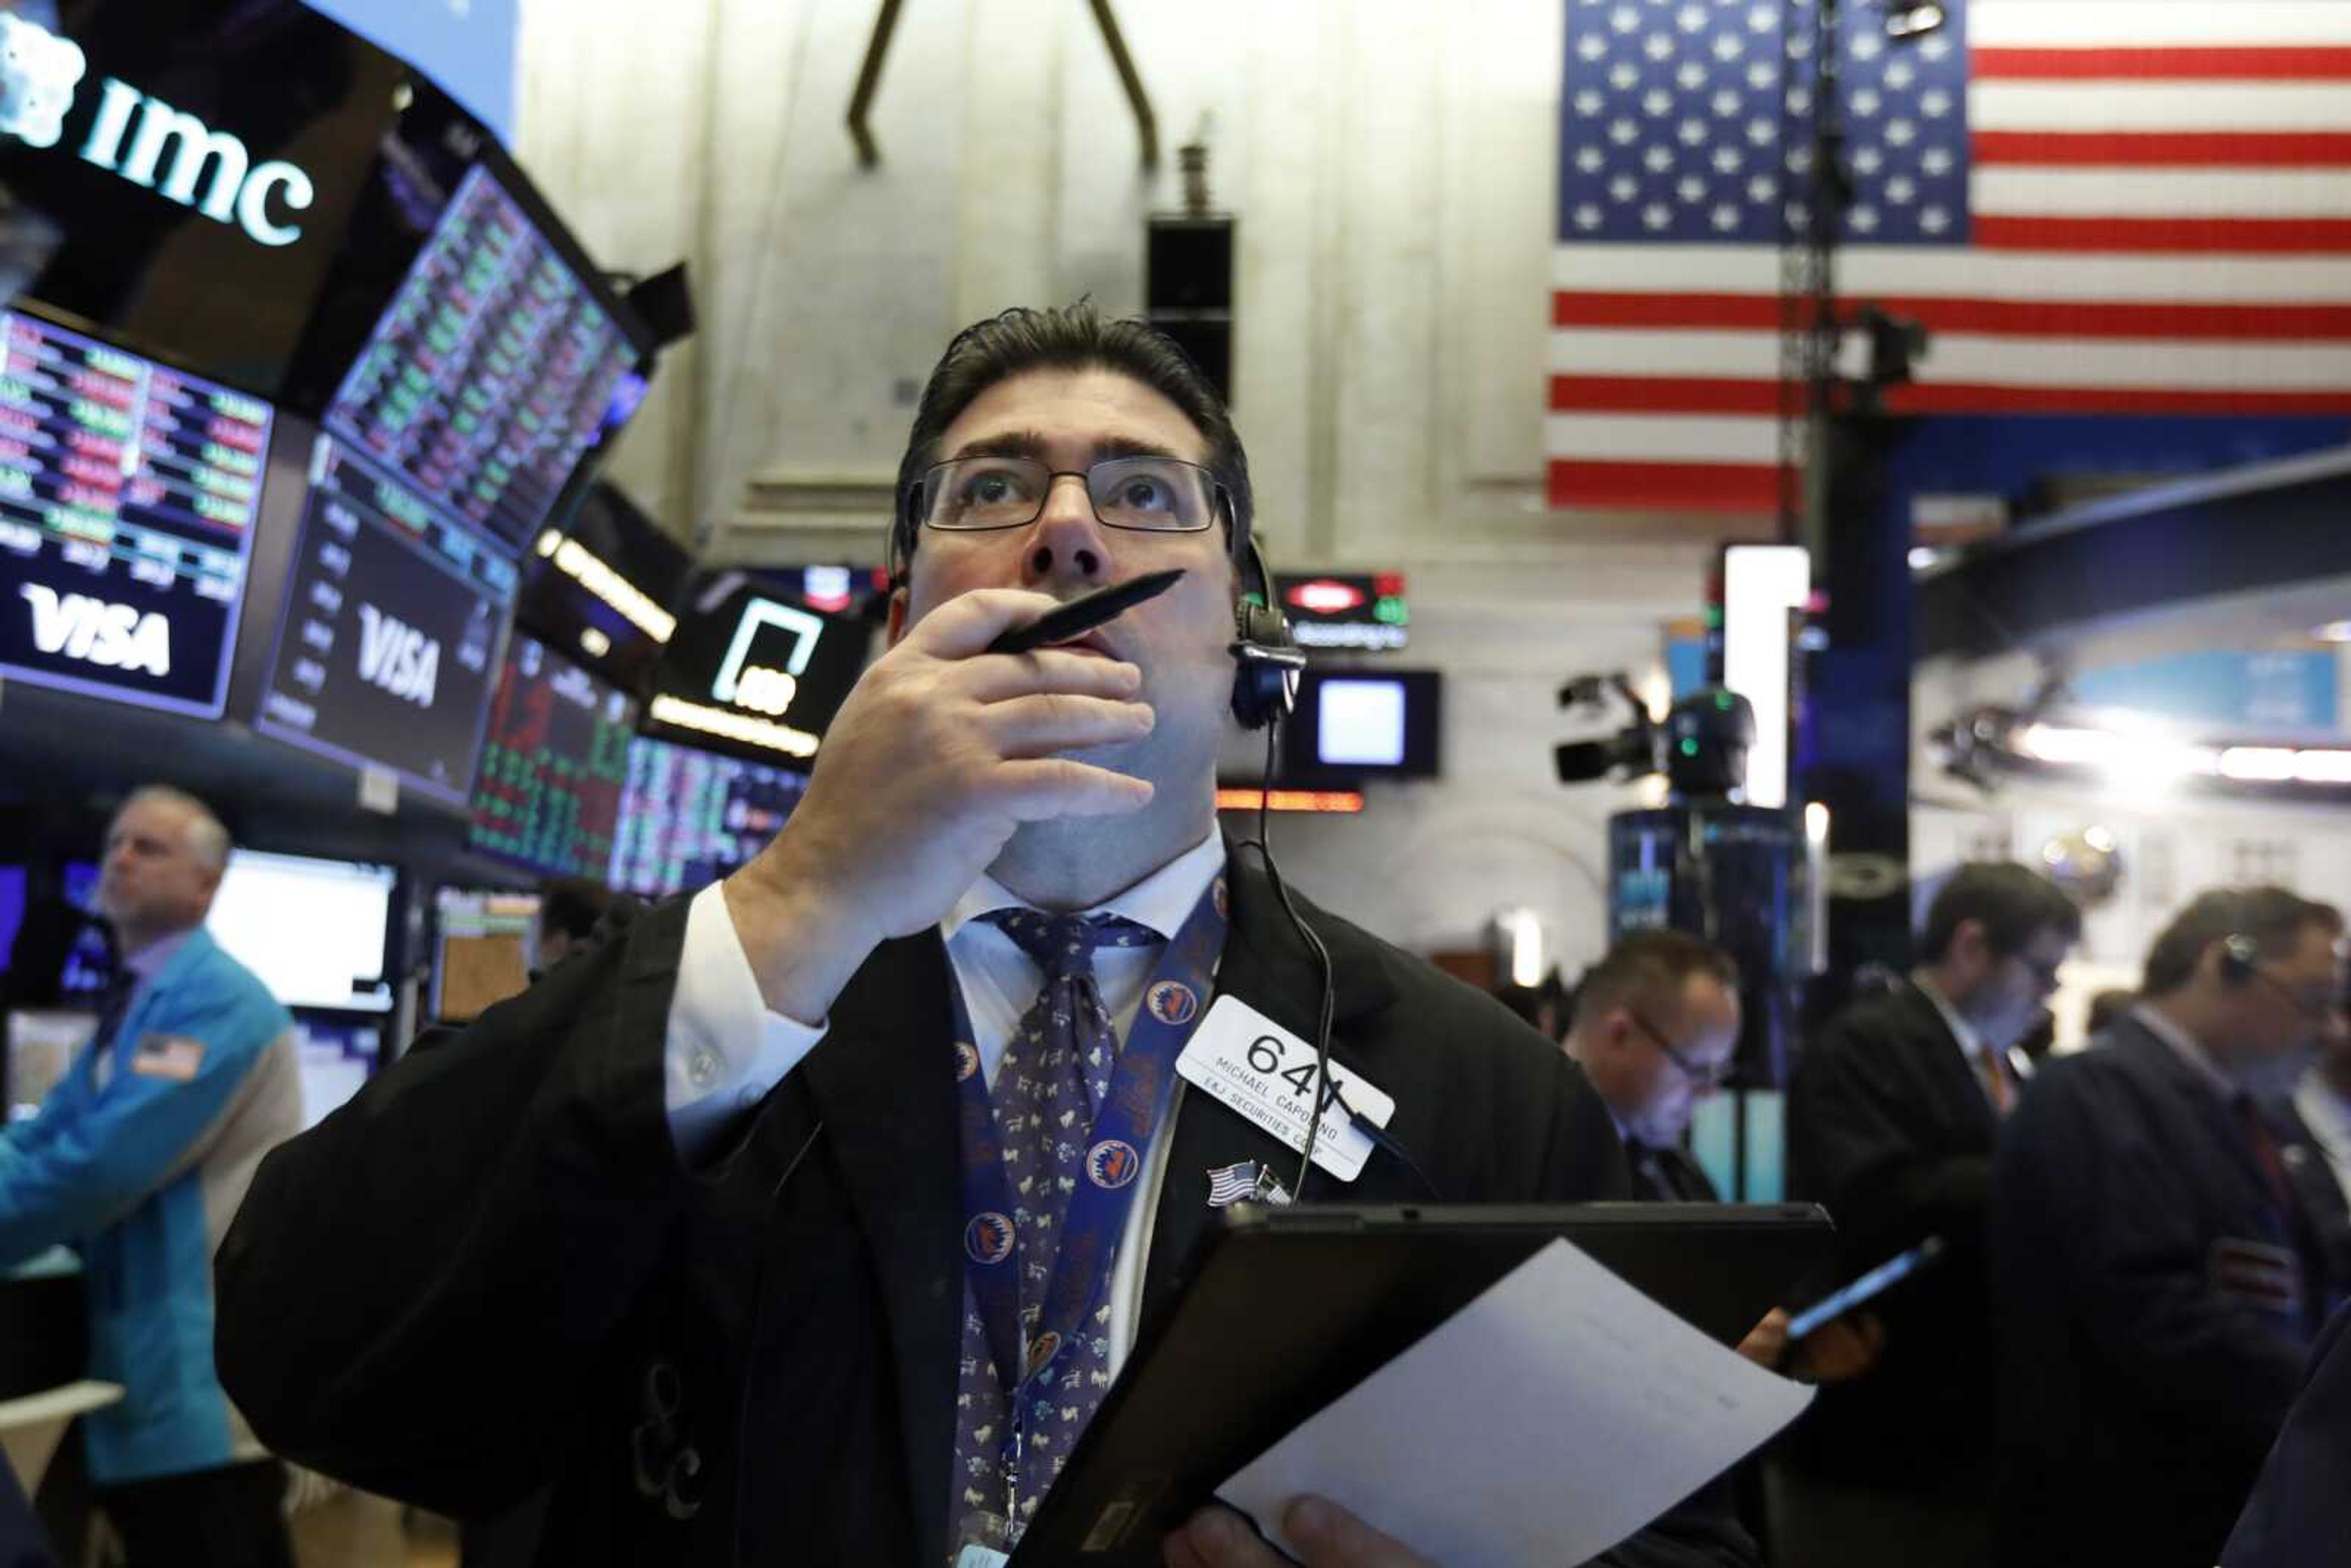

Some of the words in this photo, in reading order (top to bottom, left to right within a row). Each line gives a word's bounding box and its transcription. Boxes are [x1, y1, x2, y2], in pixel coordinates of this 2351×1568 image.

[19, 582, 170, 677] VISA
[358, 602, 440, 708] VISA
[1215, 1058, 1269, 1097] MICHAEL
[1275, 1095, 1338, 1141] CAPONO
[1230, 1092, 1290, 1135] SECURITIES
